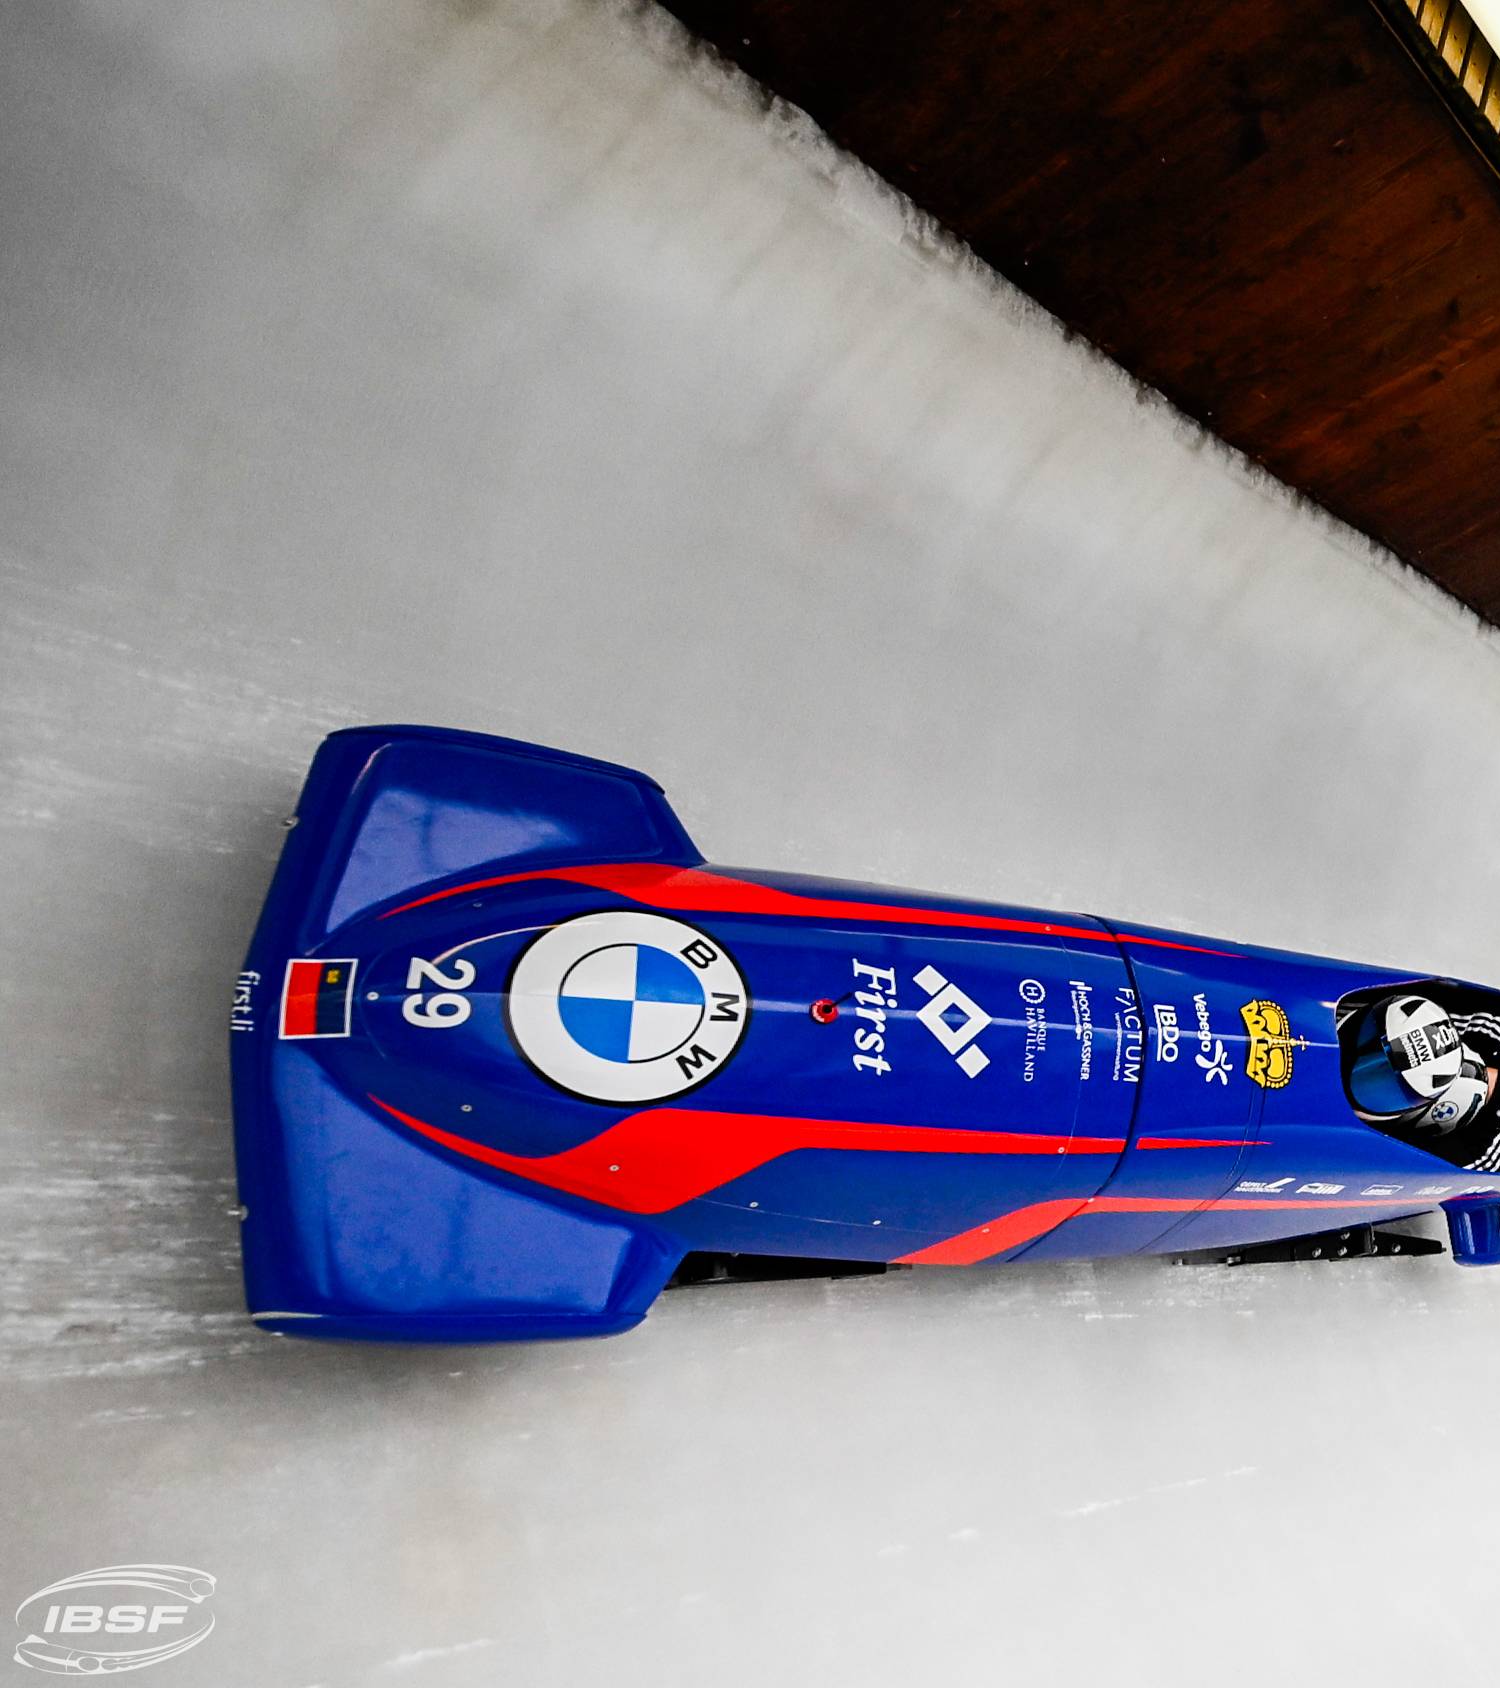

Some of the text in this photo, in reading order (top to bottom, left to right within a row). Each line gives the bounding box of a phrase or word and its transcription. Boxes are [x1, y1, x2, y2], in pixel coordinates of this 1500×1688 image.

[230, 971, 261, 1032] first.li
[402, 956, 476, 1029] 29
[675, 938, 741, 1081] BMW
[852, 958, 897, 1076] First
[1193, 992, 1212, 1053] Vebego
[1023, 1007, 1037, 1082] HAVILLAND
[1036, 1008, 1047, 1052] BANQUE
[1114, 987, 1142, 1083] FACTUM
[1409, 1028, 1432, 1062] BMW
